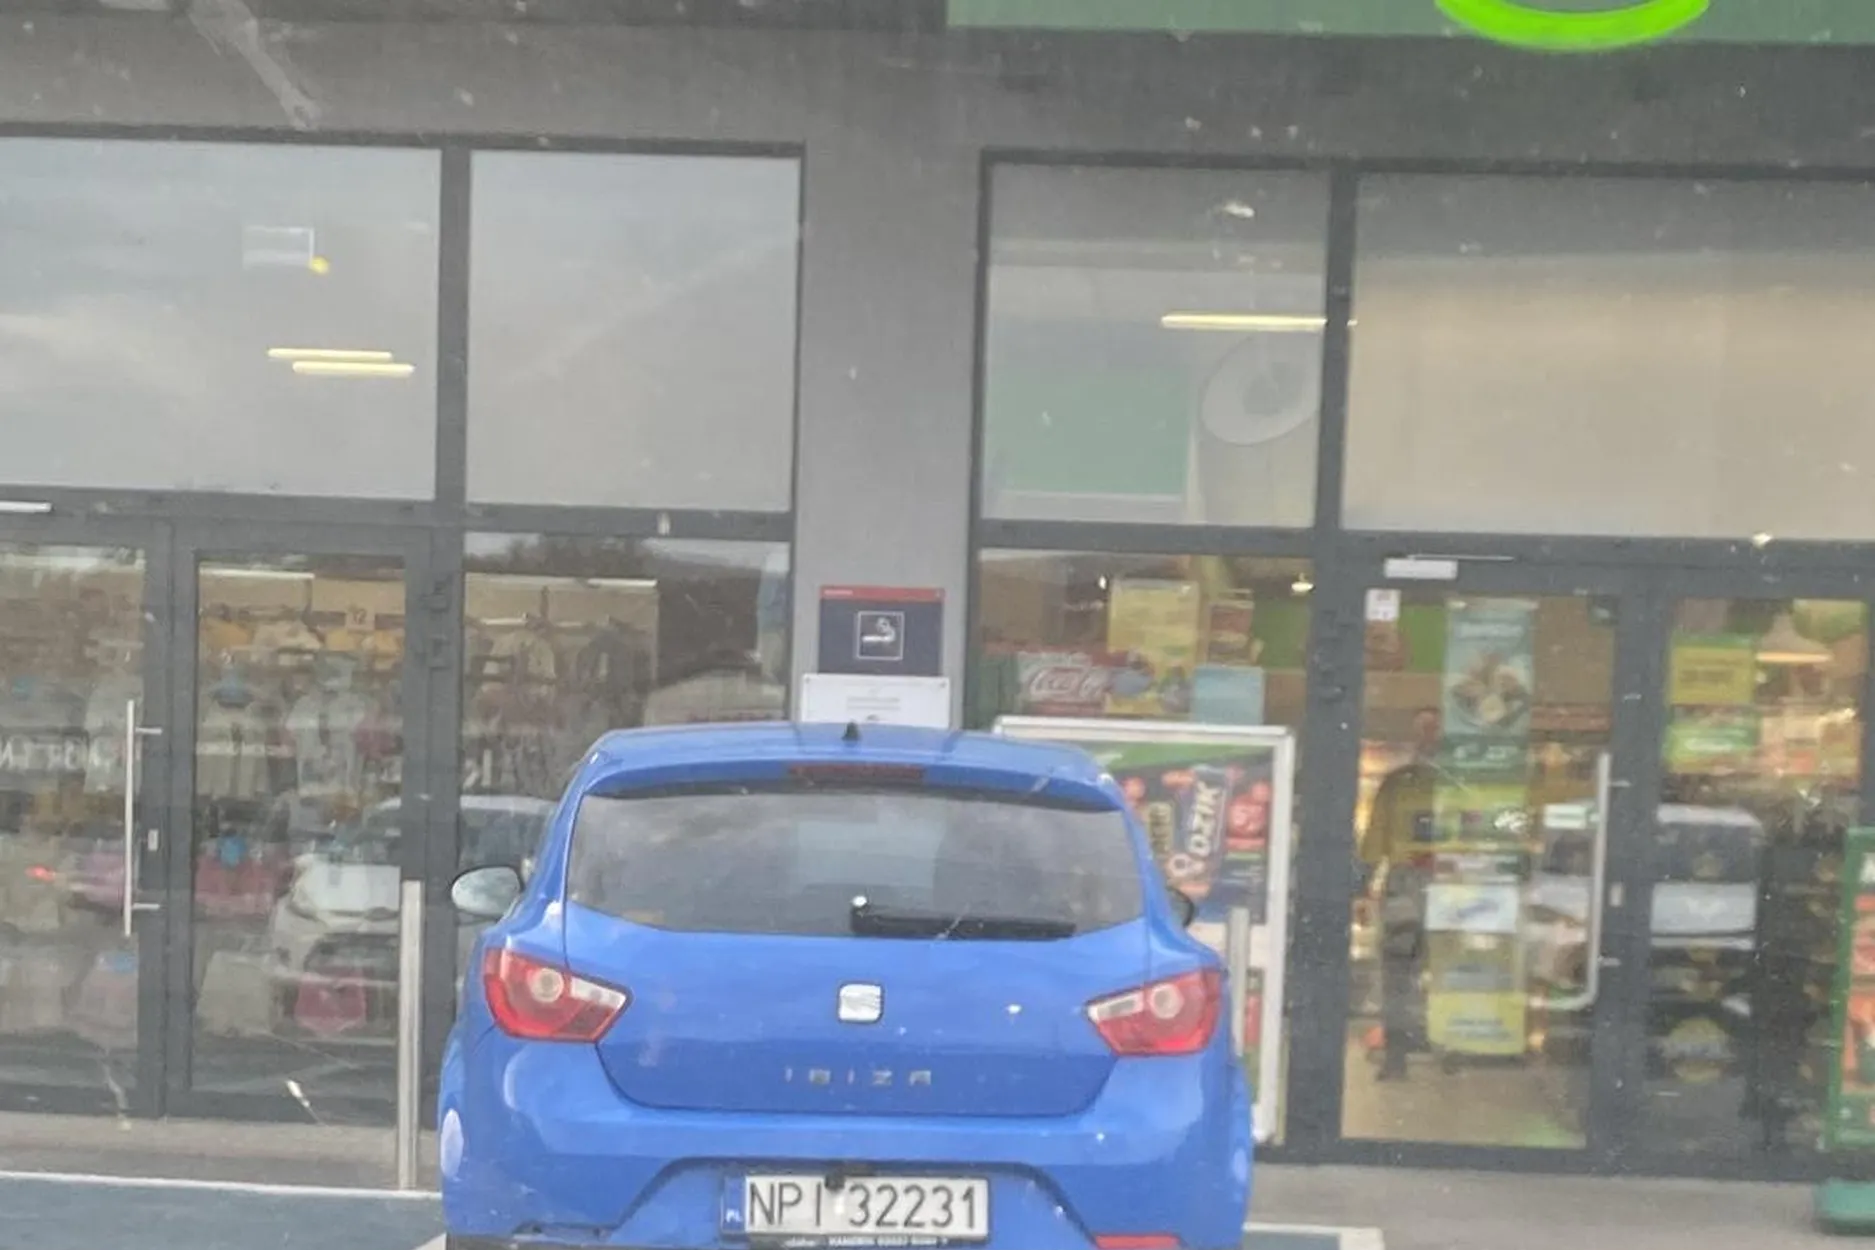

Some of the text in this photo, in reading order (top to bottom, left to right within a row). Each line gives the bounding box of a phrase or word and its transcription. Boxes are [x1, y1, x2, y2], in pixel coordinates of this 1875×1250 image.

[785, 1065, 932, 1086] IBIZA
[749, 1181, 975, 1229] NPI 32231
